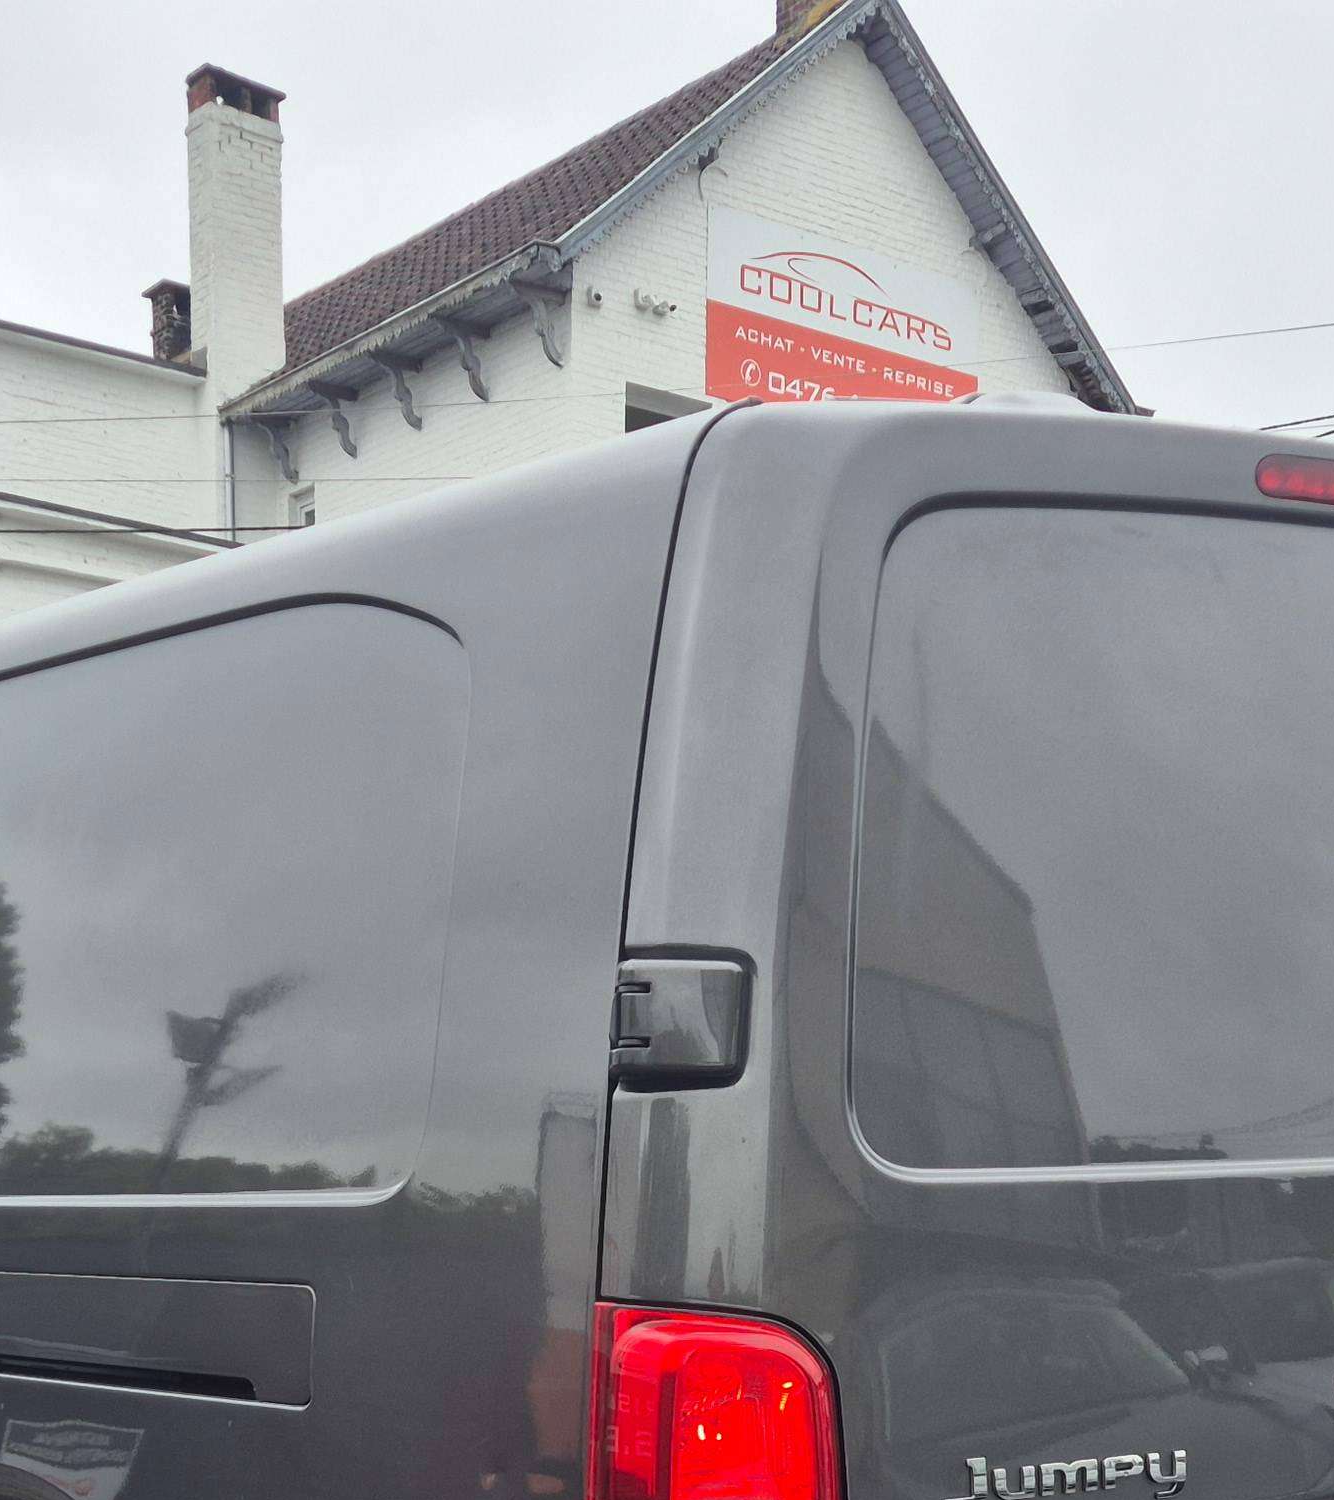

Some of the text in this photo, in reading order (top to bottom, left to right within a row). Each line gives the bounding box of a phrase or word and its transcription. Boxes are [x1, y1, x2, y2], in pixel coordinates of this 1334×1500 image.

[735, 325, 955, 398] ACHAT VENTE REPRISE
